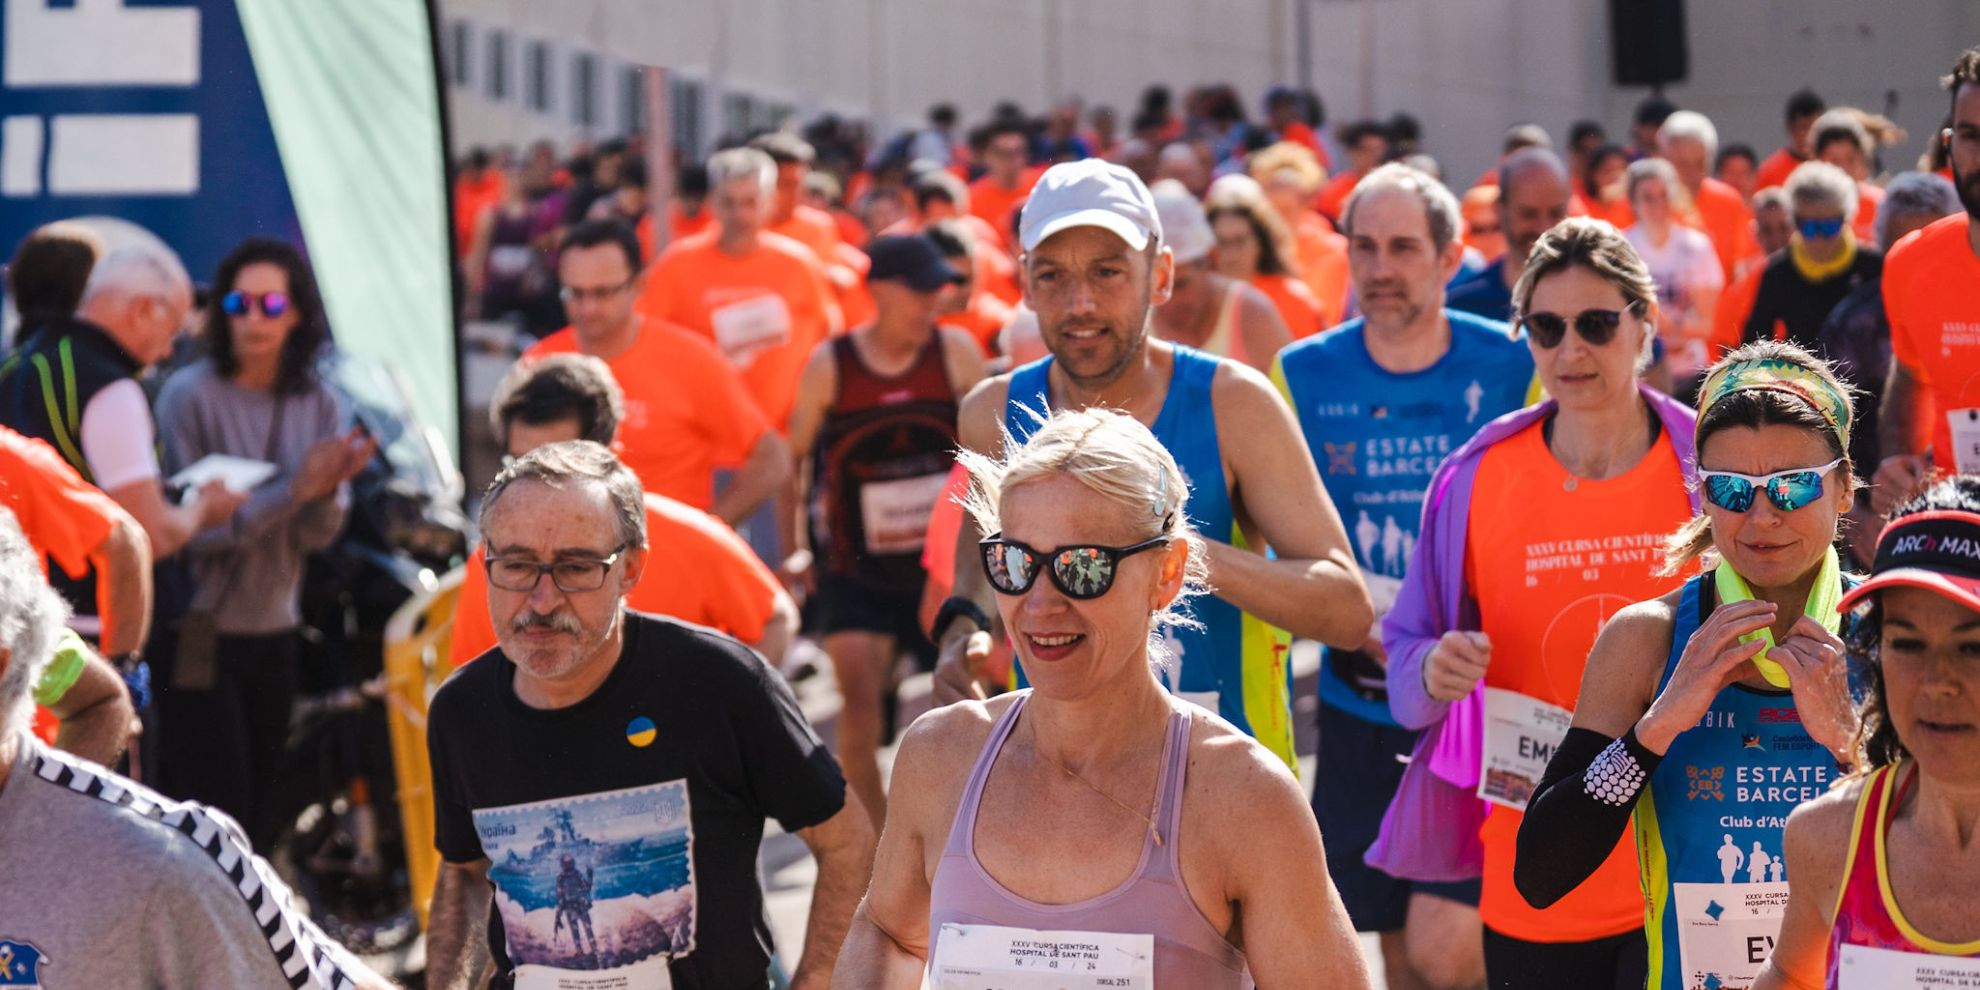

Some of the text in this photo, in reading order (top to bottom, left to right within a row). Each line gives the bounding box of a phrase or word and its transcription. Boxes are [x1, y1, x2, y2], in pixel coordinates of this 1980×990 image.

[1365, 434, 1449, 457] ESTATE
[1366, 456, 1441, 478] BARCE
[1557, 539, 1601, 553] CURSA
[1526, 553, 1584, 571] HOSPITAL
[1589, 552, 1606, 566] DE
[1612, 549, 1648, 564] SANT
[1582, 568, 1600, 581] 03
[1736, 766, 1827, 783] ESTATE
[1720, 816, 1753, 828] Club
[1012, 940, 1100, 951] XXXV CURSA CIENTÍFICA
[1010, 949, 1099, 960] HOSPITAL DE SANT PAU
[1015, 958, 1023, 966] 16
[1087, 962, 1096, 970] 24
[1116, 978, 1130, 987] 251
[1915, 976, 1955, 985] HOSPITAL
